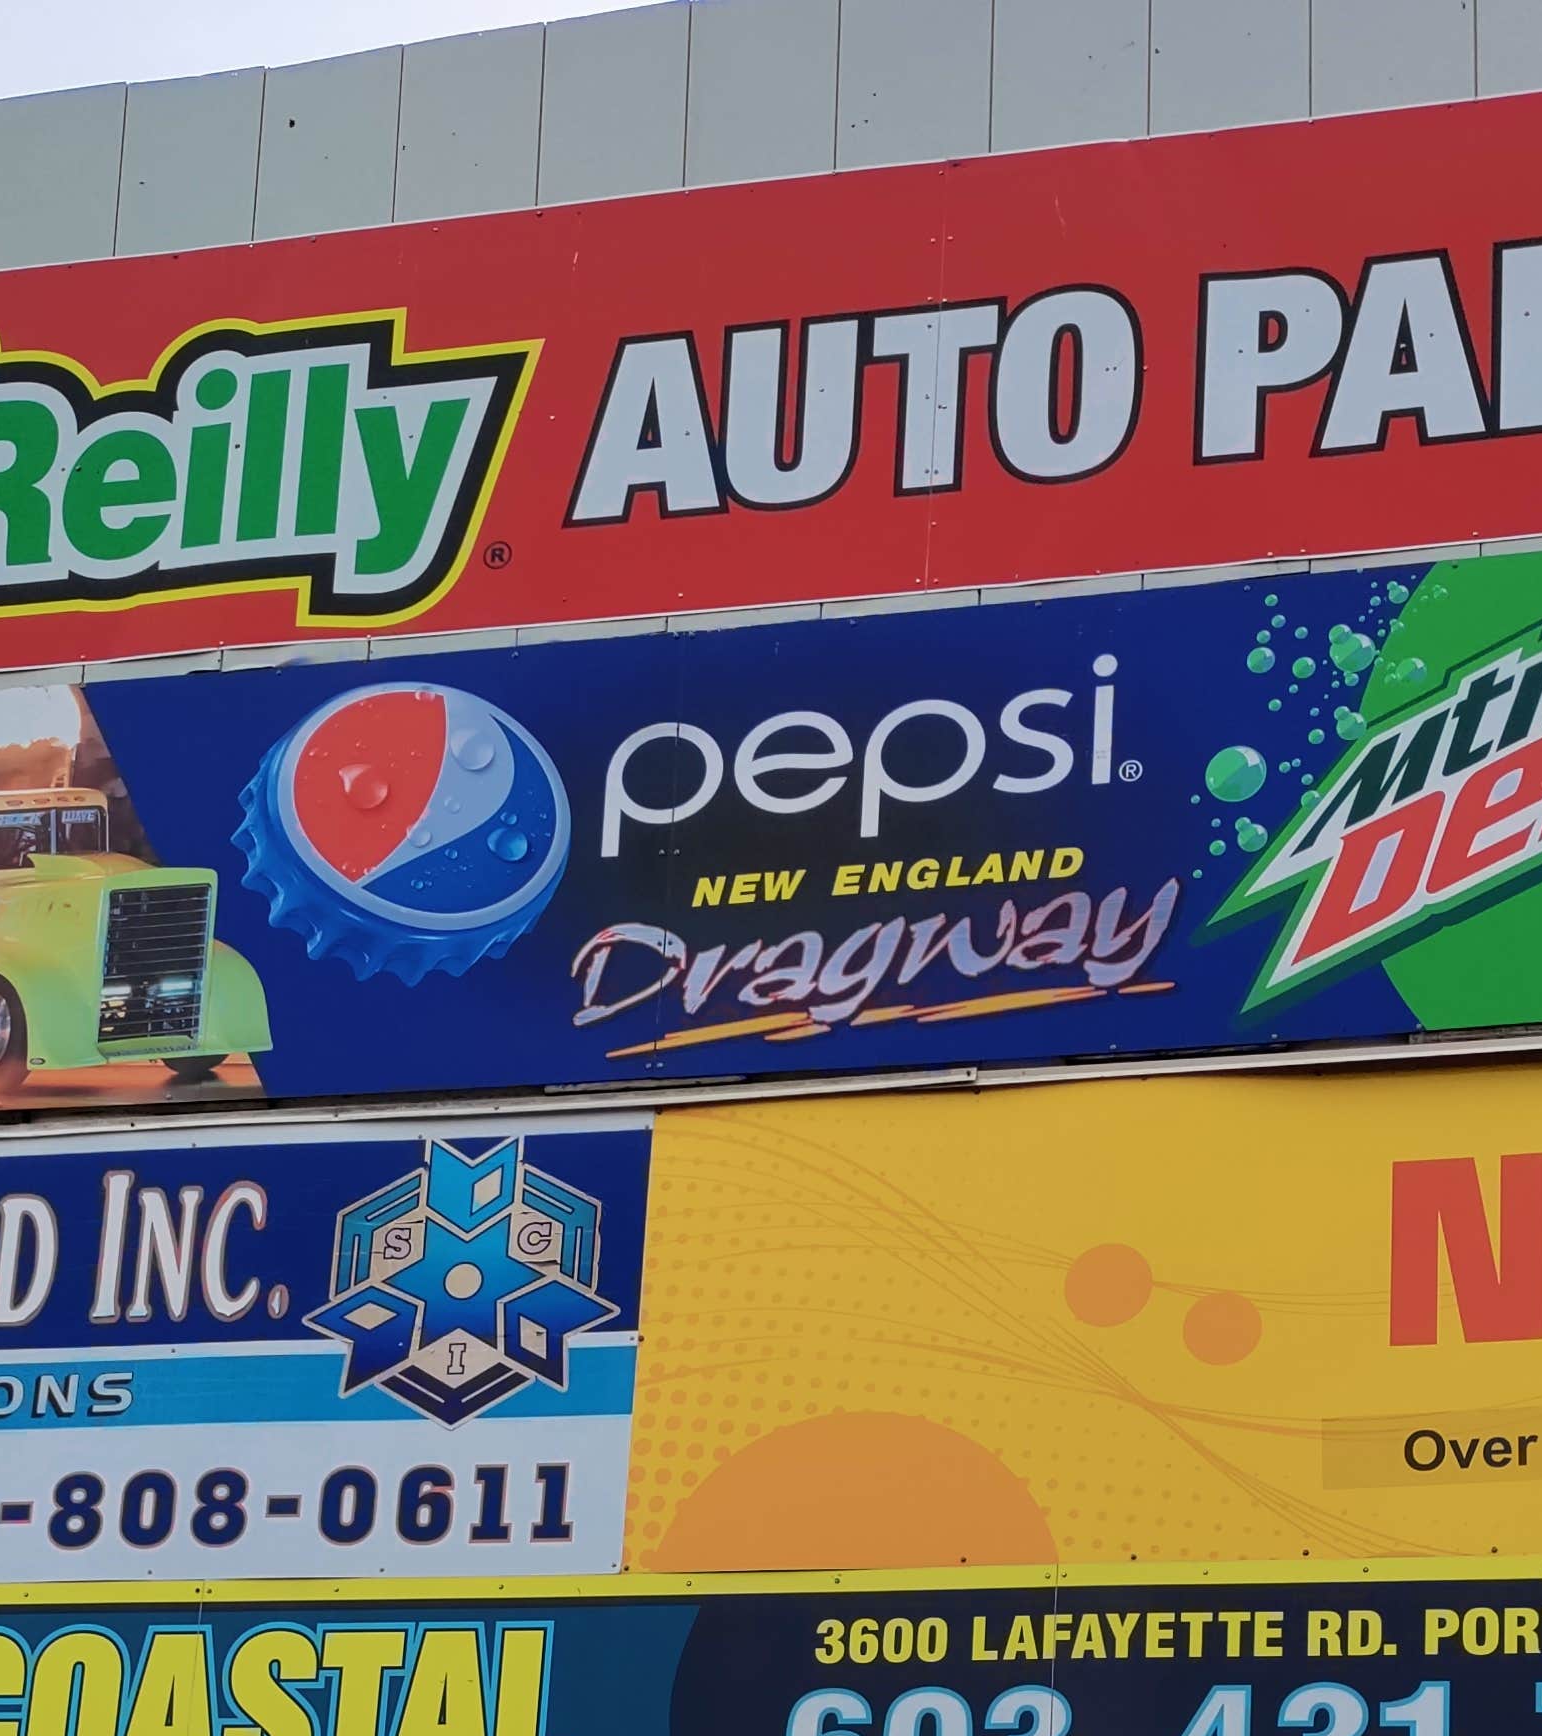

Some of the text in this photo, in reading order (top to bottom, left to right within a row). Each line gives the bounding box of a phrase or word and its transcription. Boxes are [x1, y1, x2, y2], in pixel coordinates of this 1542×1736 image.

[564, 285, 1142, 527] AUTO
[600, 653, 1118, 857] pepsi
[692, 845, 1085, 907] NEW ENGLAND
[571, 877, 1181, 1028] Dragway
[86, 1168, 292, 1324] INC.
[1403, 1427, 1539, 1471] Over
[814, 1617, 948, 1664] 3600
[969, 1610, 1283, 1660] LAFAYETTE
[1308, 1606, 1399, 1656] RD.
